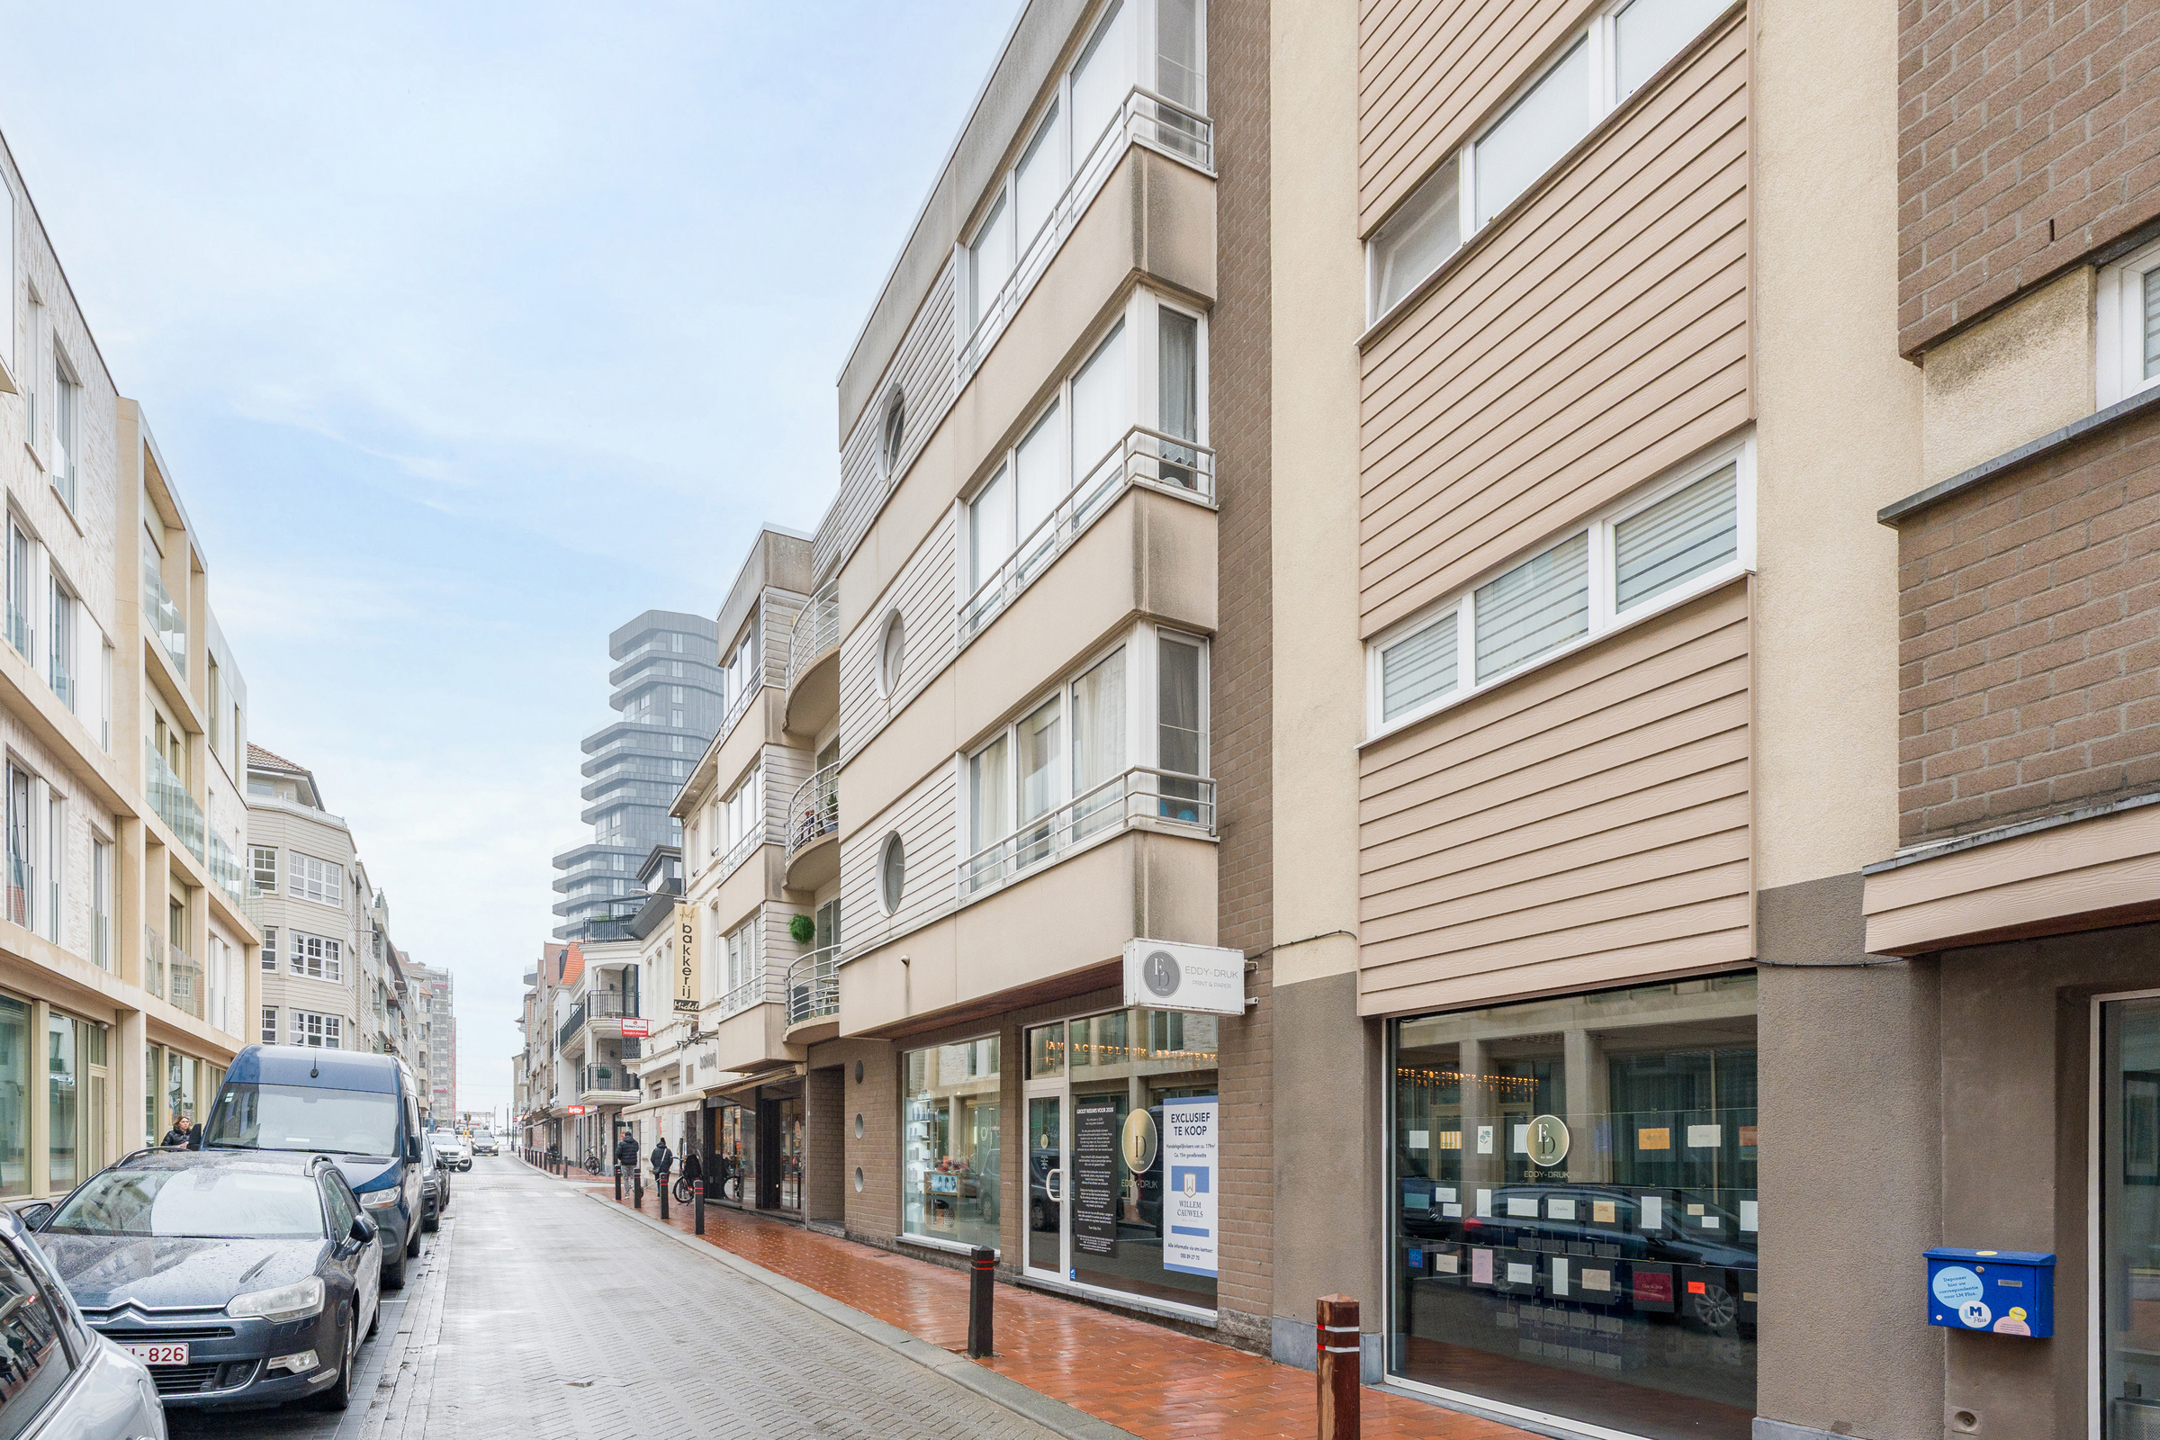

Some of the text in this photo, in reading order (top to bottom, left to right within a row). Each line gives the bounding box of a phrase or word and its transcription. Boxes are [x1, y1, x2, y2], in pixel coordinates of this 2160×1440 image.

[682, 923, 693, 999] bakkerij
[1184, 965, 1239, 980] EDDY-DRUK
[1192, 979, 1208, 987] PRINT
[1213, 982, 1232, 990] PAPER
[674, 1001, 699, 1011] Michel
[1048, 1041, 1147, 1057] AMACHTELIJK
[1171, 1112, 1211, 1123] EXCLUSIEF
[1174, 1125, 1207, 1136] TE KOOP
[1524, 1170, 1570, 1179] EDDY-DRUK
[1121, 1179, 1159, 1189] EDDY-DRUK
[1178, 1200, 1202, 1209] WILLEM
[1176, 1209, 1204, 1218] CAUWELS
[1939, 1286, 1979, 1294] correspondentie
[125, 1347, 184, 1362] -826
